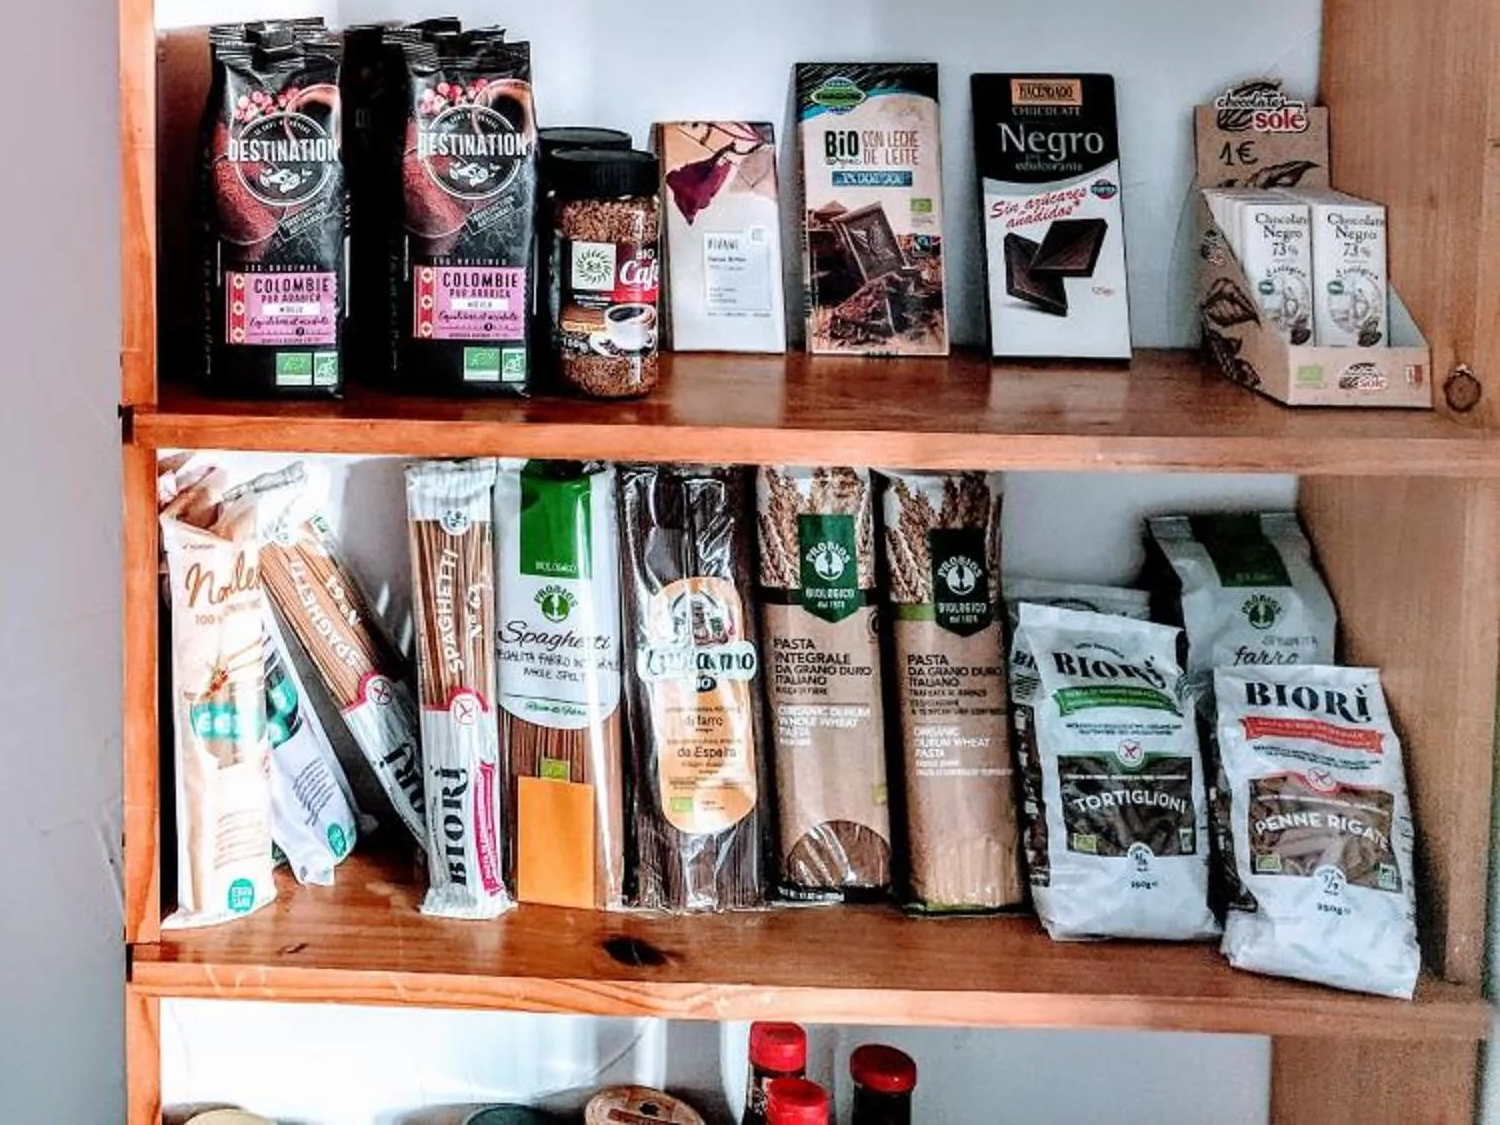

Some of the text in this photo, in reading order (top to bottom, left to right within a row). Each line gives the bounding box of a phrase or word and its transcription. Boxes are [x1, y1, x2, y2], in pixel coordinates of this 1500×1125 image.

[416, 133, 527, 157] DESTINATION
[824, 130, 859, 157] BiO
[997, 121, 1104, 161] Negro
[228, 138, 339, 162] DESTINATION
[1219, 140, 1259, 166] 1€
[1264, 225, 1304, 241] Negro
[1334, 226, 1378, 241] Negro
[253, 277, 330, 294] COLOMBIE
[442, 272, 519, 289] COLOMBIE
[805, 540, 852, 565] PROBIOS
[773, 637, 816, 650] PASTA
[775, 652, 852, 665] INTEGRALE
[907, 654, 949, 666] PASTA
[1233, 645, 1299, 667] farro
[775, 665, 873, 677] DA GRANO DURO
[907, 666, 1003, 677] DA GRANO DURO
[775, 675, 827, 687] ITALIANO
[908, 676, 960, 688] ITALIANO
[1074, 789, 1189, 816] TORTIGLIONI
[1254, 812, 1390, 853] PENNE RIGATE
